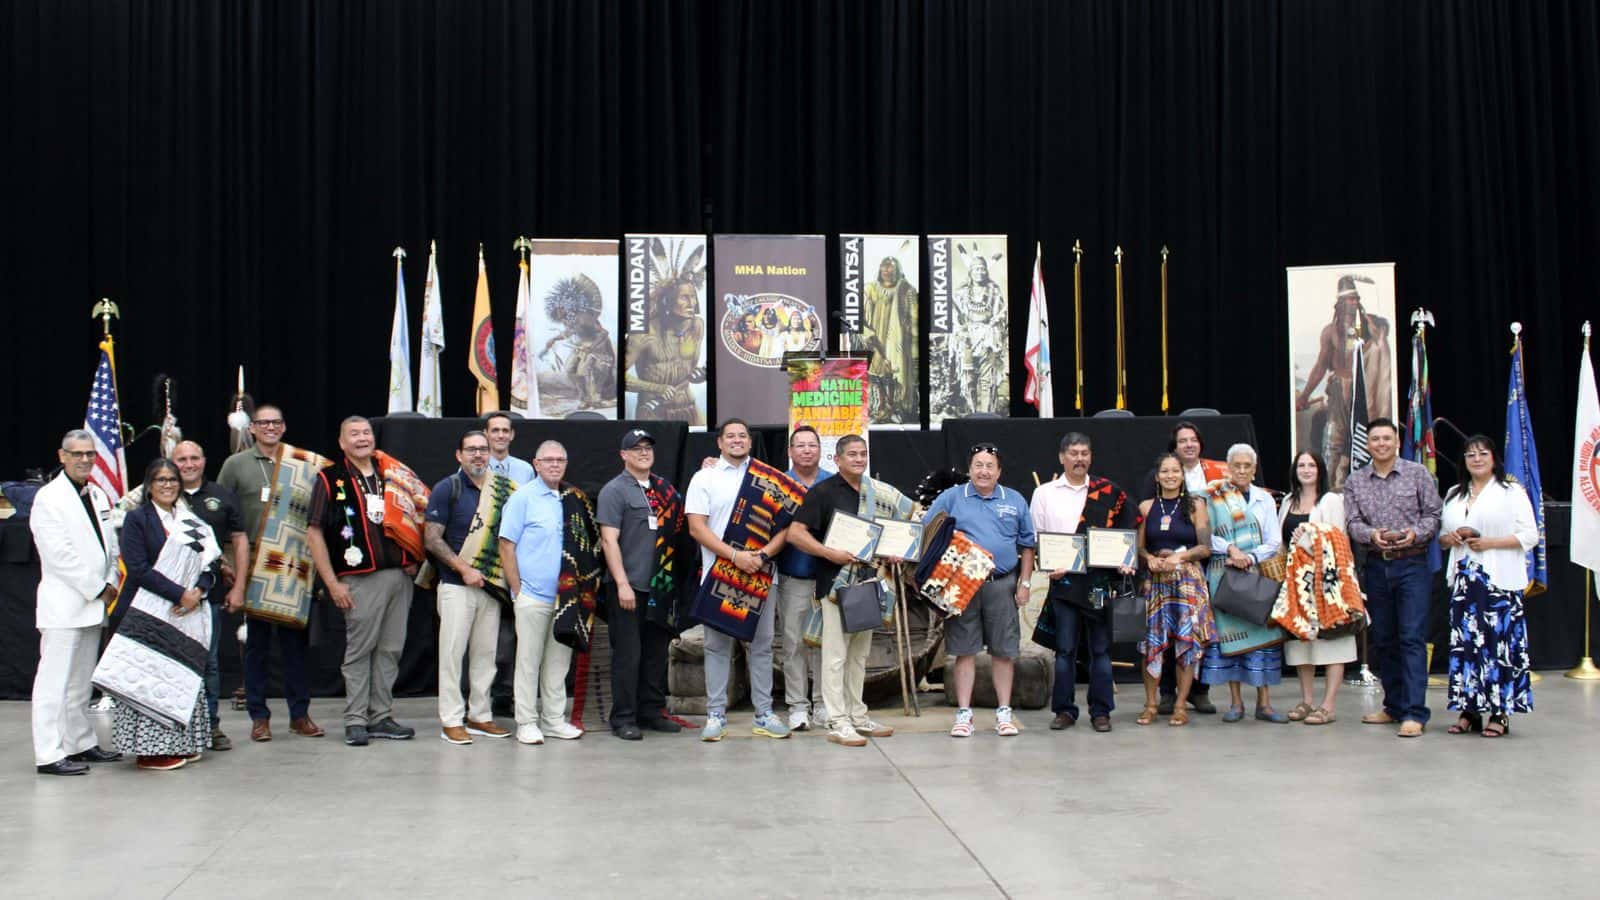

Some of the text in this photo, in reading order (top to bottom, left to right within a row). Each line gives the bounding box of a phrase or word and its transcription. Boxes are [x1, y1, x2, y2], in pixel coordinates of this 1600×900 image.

[630, 239, 645, 331] MANDAN
[735, 264, 806, 275] MHA Nation
[845, 238, 859, 331] HIDATSA
[933, 239, 948, 331] ARIKARA
[792, 391, 863, 407] MEDICINE
[821, 379, 863, 391] NATIVE
